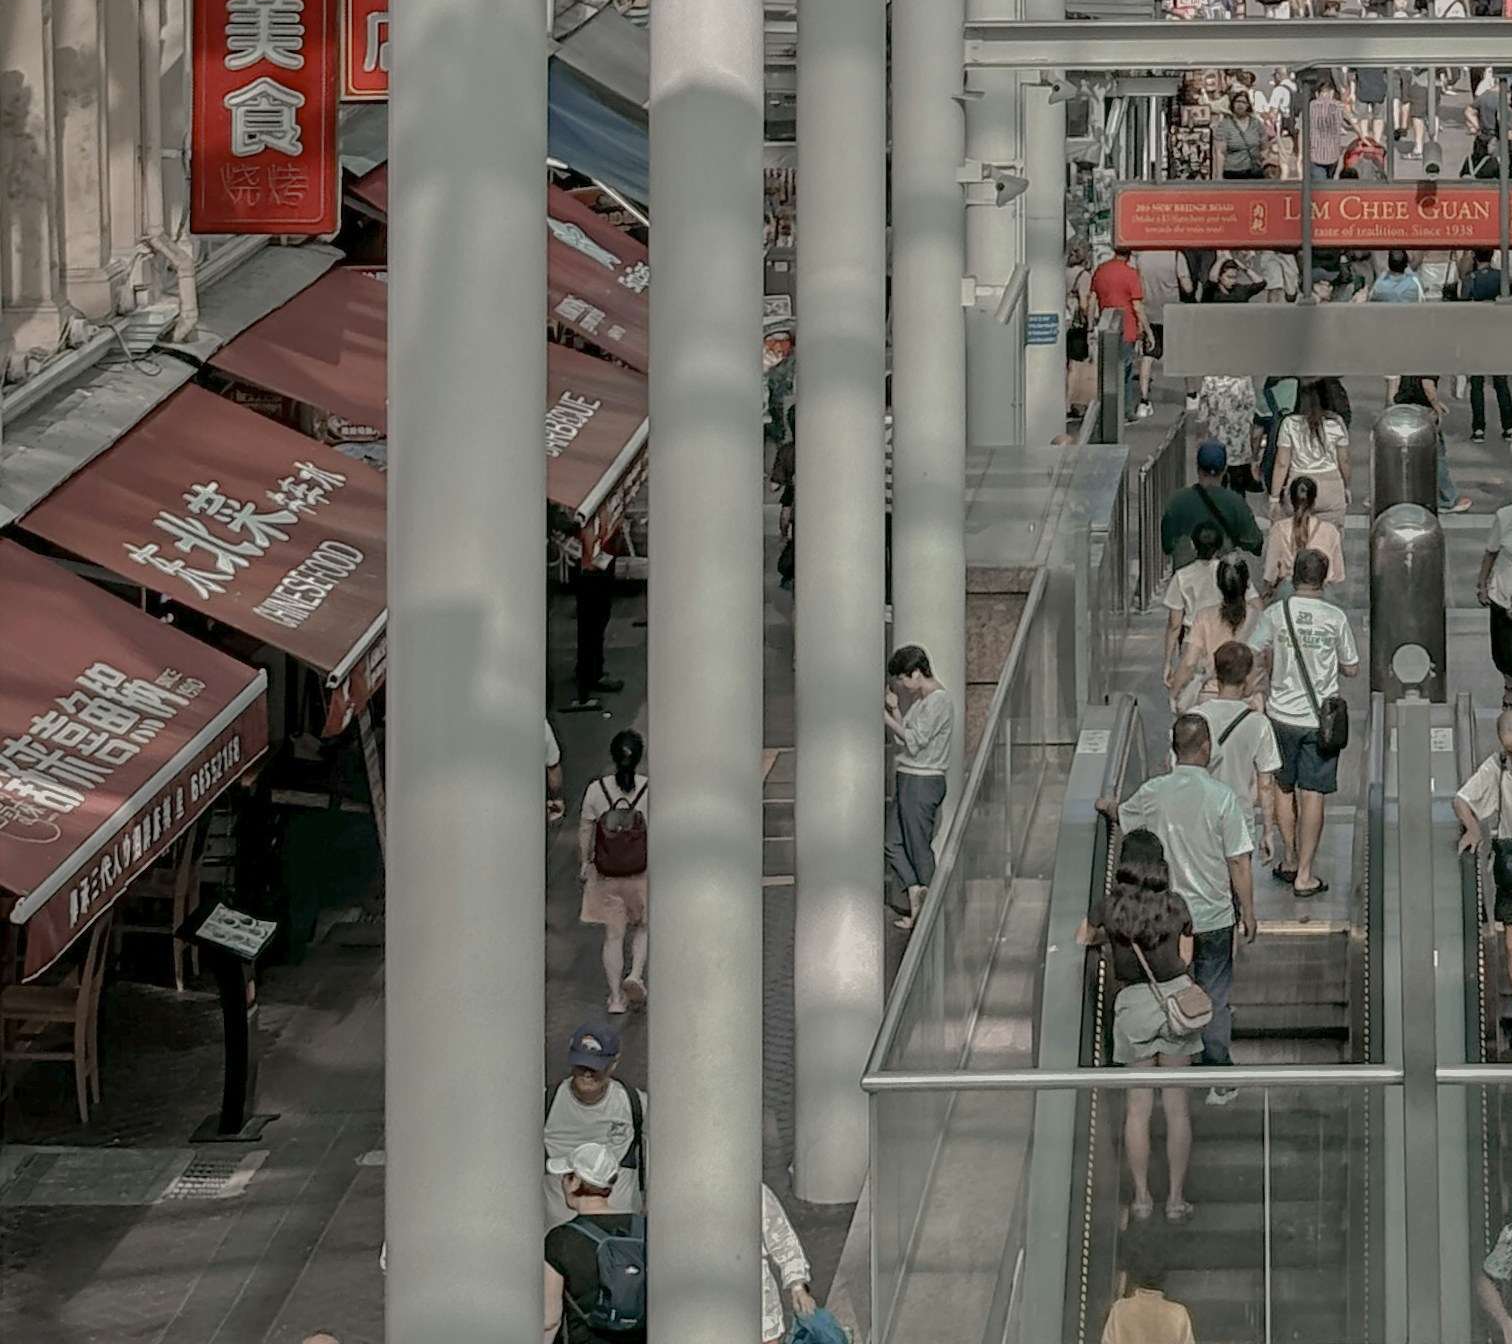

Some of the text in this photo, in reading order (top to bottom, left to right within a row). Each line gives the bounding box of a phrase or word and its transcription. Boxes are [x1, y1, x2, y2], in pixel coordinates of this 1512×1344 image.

[221, 162, 309, 208] 烧烤
[1339, 195, 1410, 222] CHEE
[1418, 196, 1490, 221] GUAN
[1411, 224, 1441, 237] Since
[1446, 224, 1474, 237] 1938
